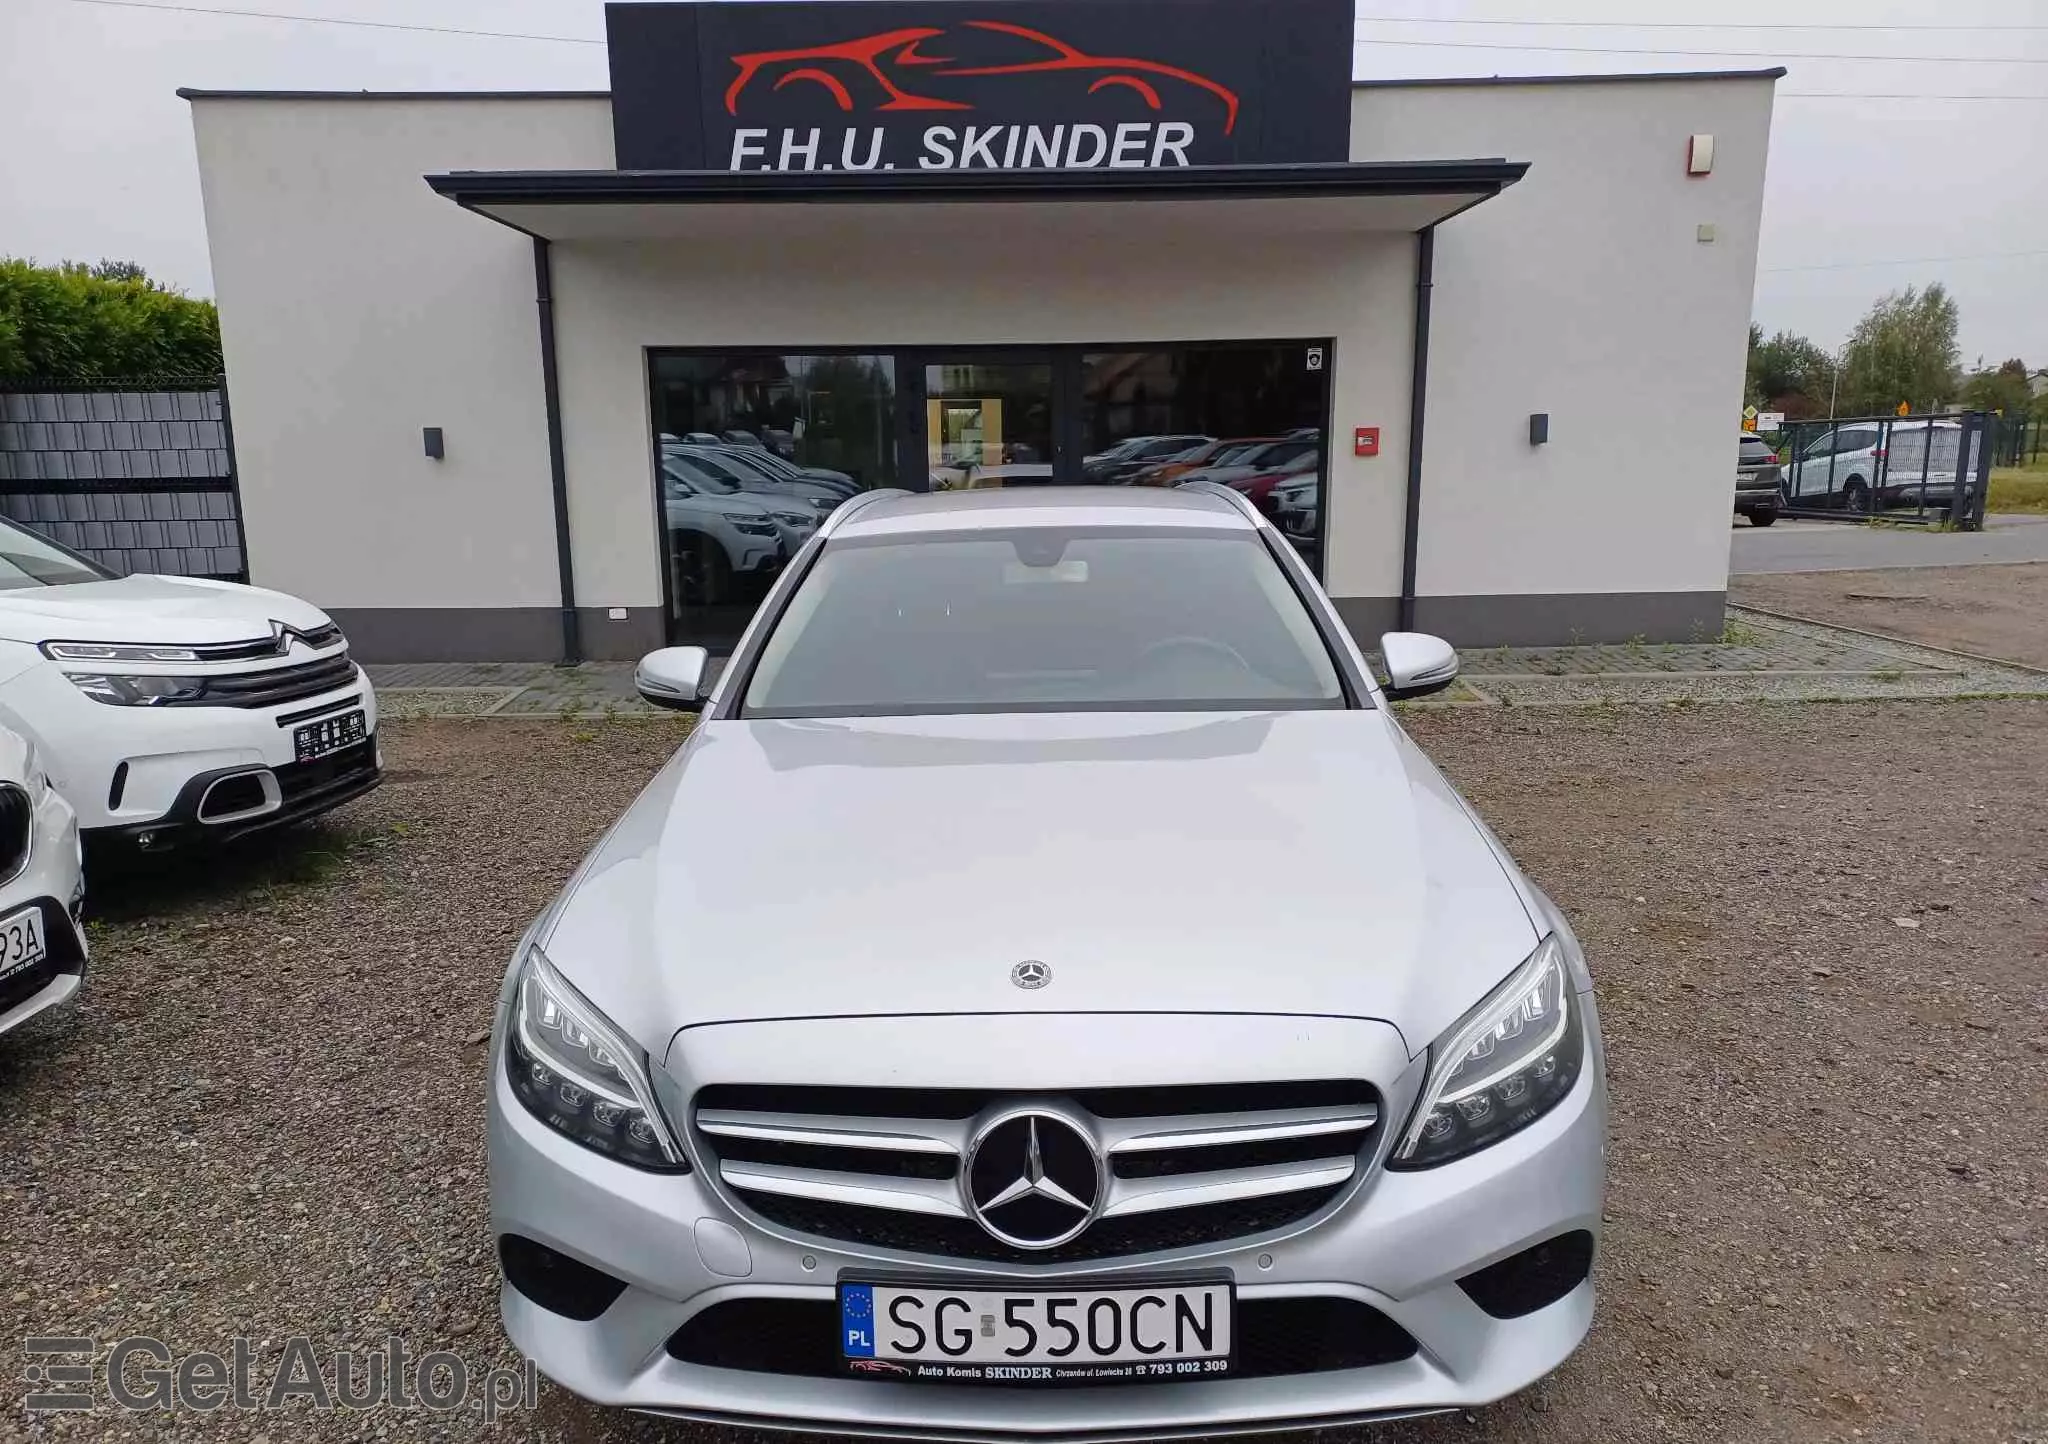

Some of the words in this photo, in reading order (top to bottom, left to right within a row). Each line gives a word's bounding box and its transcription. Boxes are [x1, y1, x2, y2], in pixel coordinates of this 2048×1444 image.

[918, 121, 1195, 169] SKINDER
[848, 1330, 870, 1347] PL
[888, 1295, 973, 1356] SG
[1003, 1293, 1213, 1357] 550CN
[918, 1365, 944, 1377] Auto
[946, 1366, 982, 1378] Komis
[985, 1366, 1053, 1379] SKINDER
[1150, 1364, 1173, 1375] 793
[1176, 1362, 1200, 1373] 002
[1204, 1360, 1228, 1371] 309
